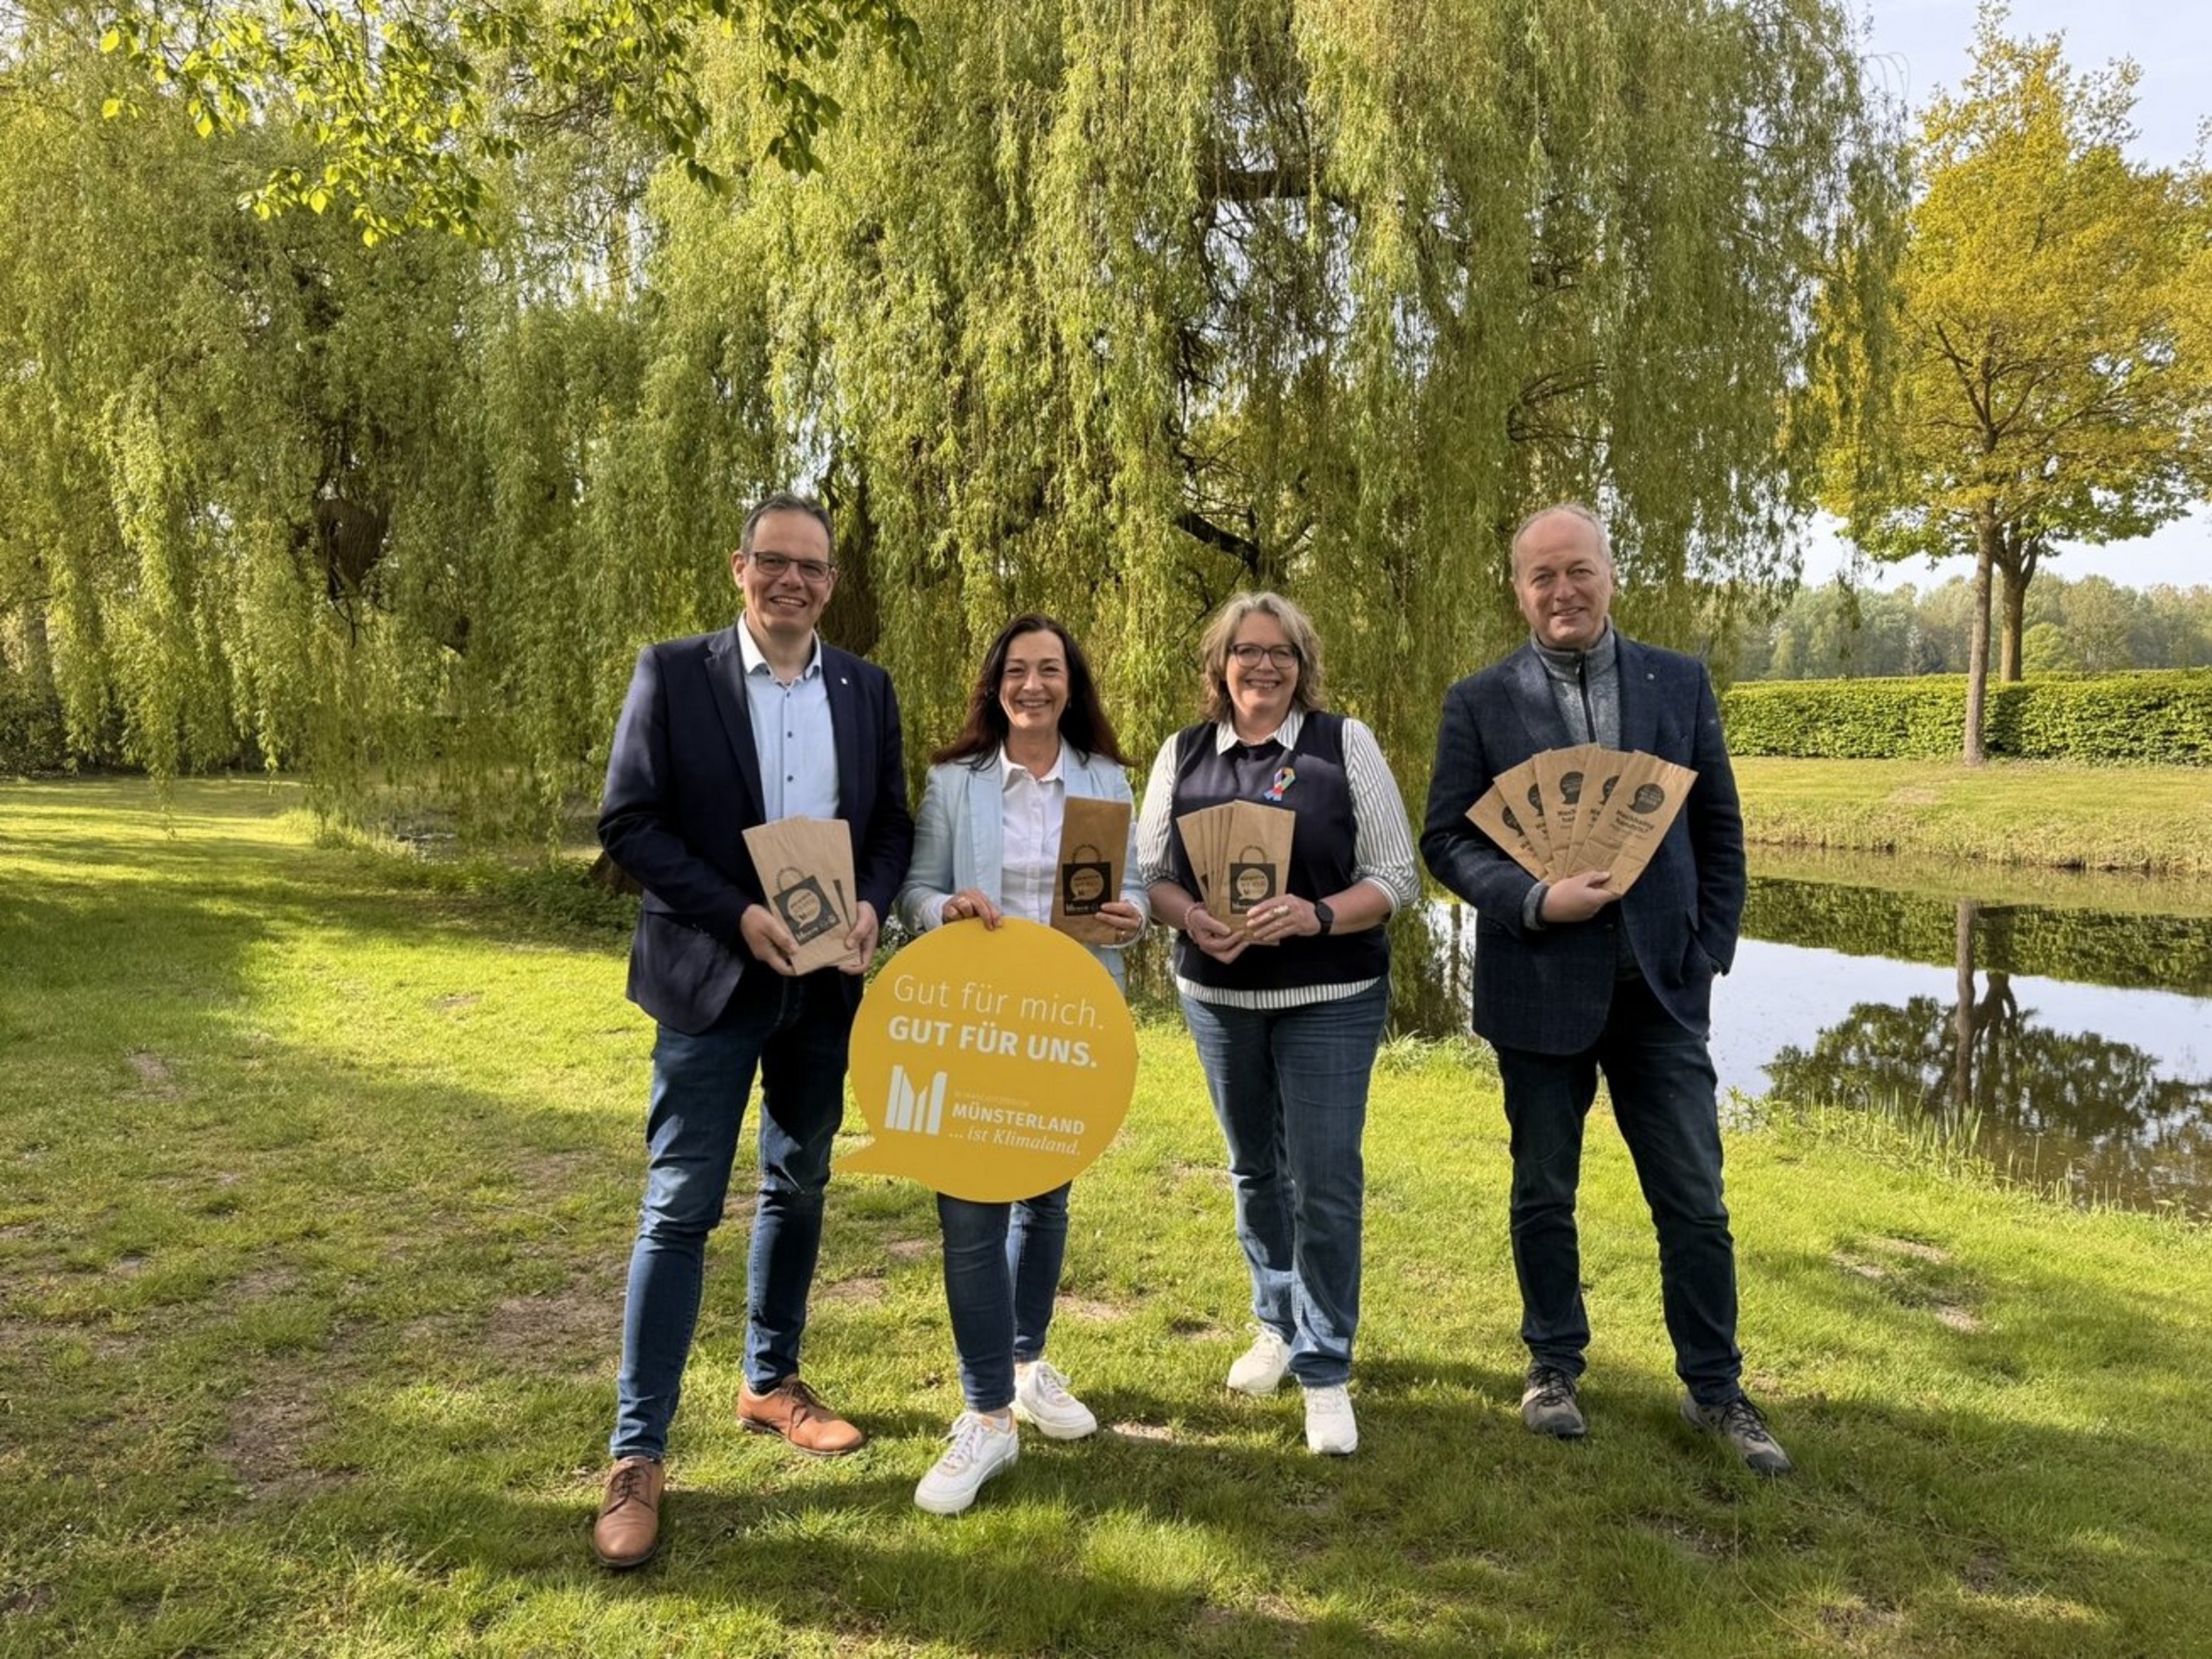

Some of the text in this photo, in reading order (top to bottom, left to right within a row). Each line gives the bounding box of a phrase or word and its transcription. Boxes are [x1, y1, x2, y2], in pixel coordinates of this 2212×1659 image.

[894, 975, 1105, 1031] Gut für mich.
[888, 1016, 1098, 1069] GUT FÜR UNS.
[953, 1102, 1086, 1136] MÜNSTERLAND
[968, 1127, 989, 1143] ist
[993, 1130, 1081, 1156] Klimaland.
